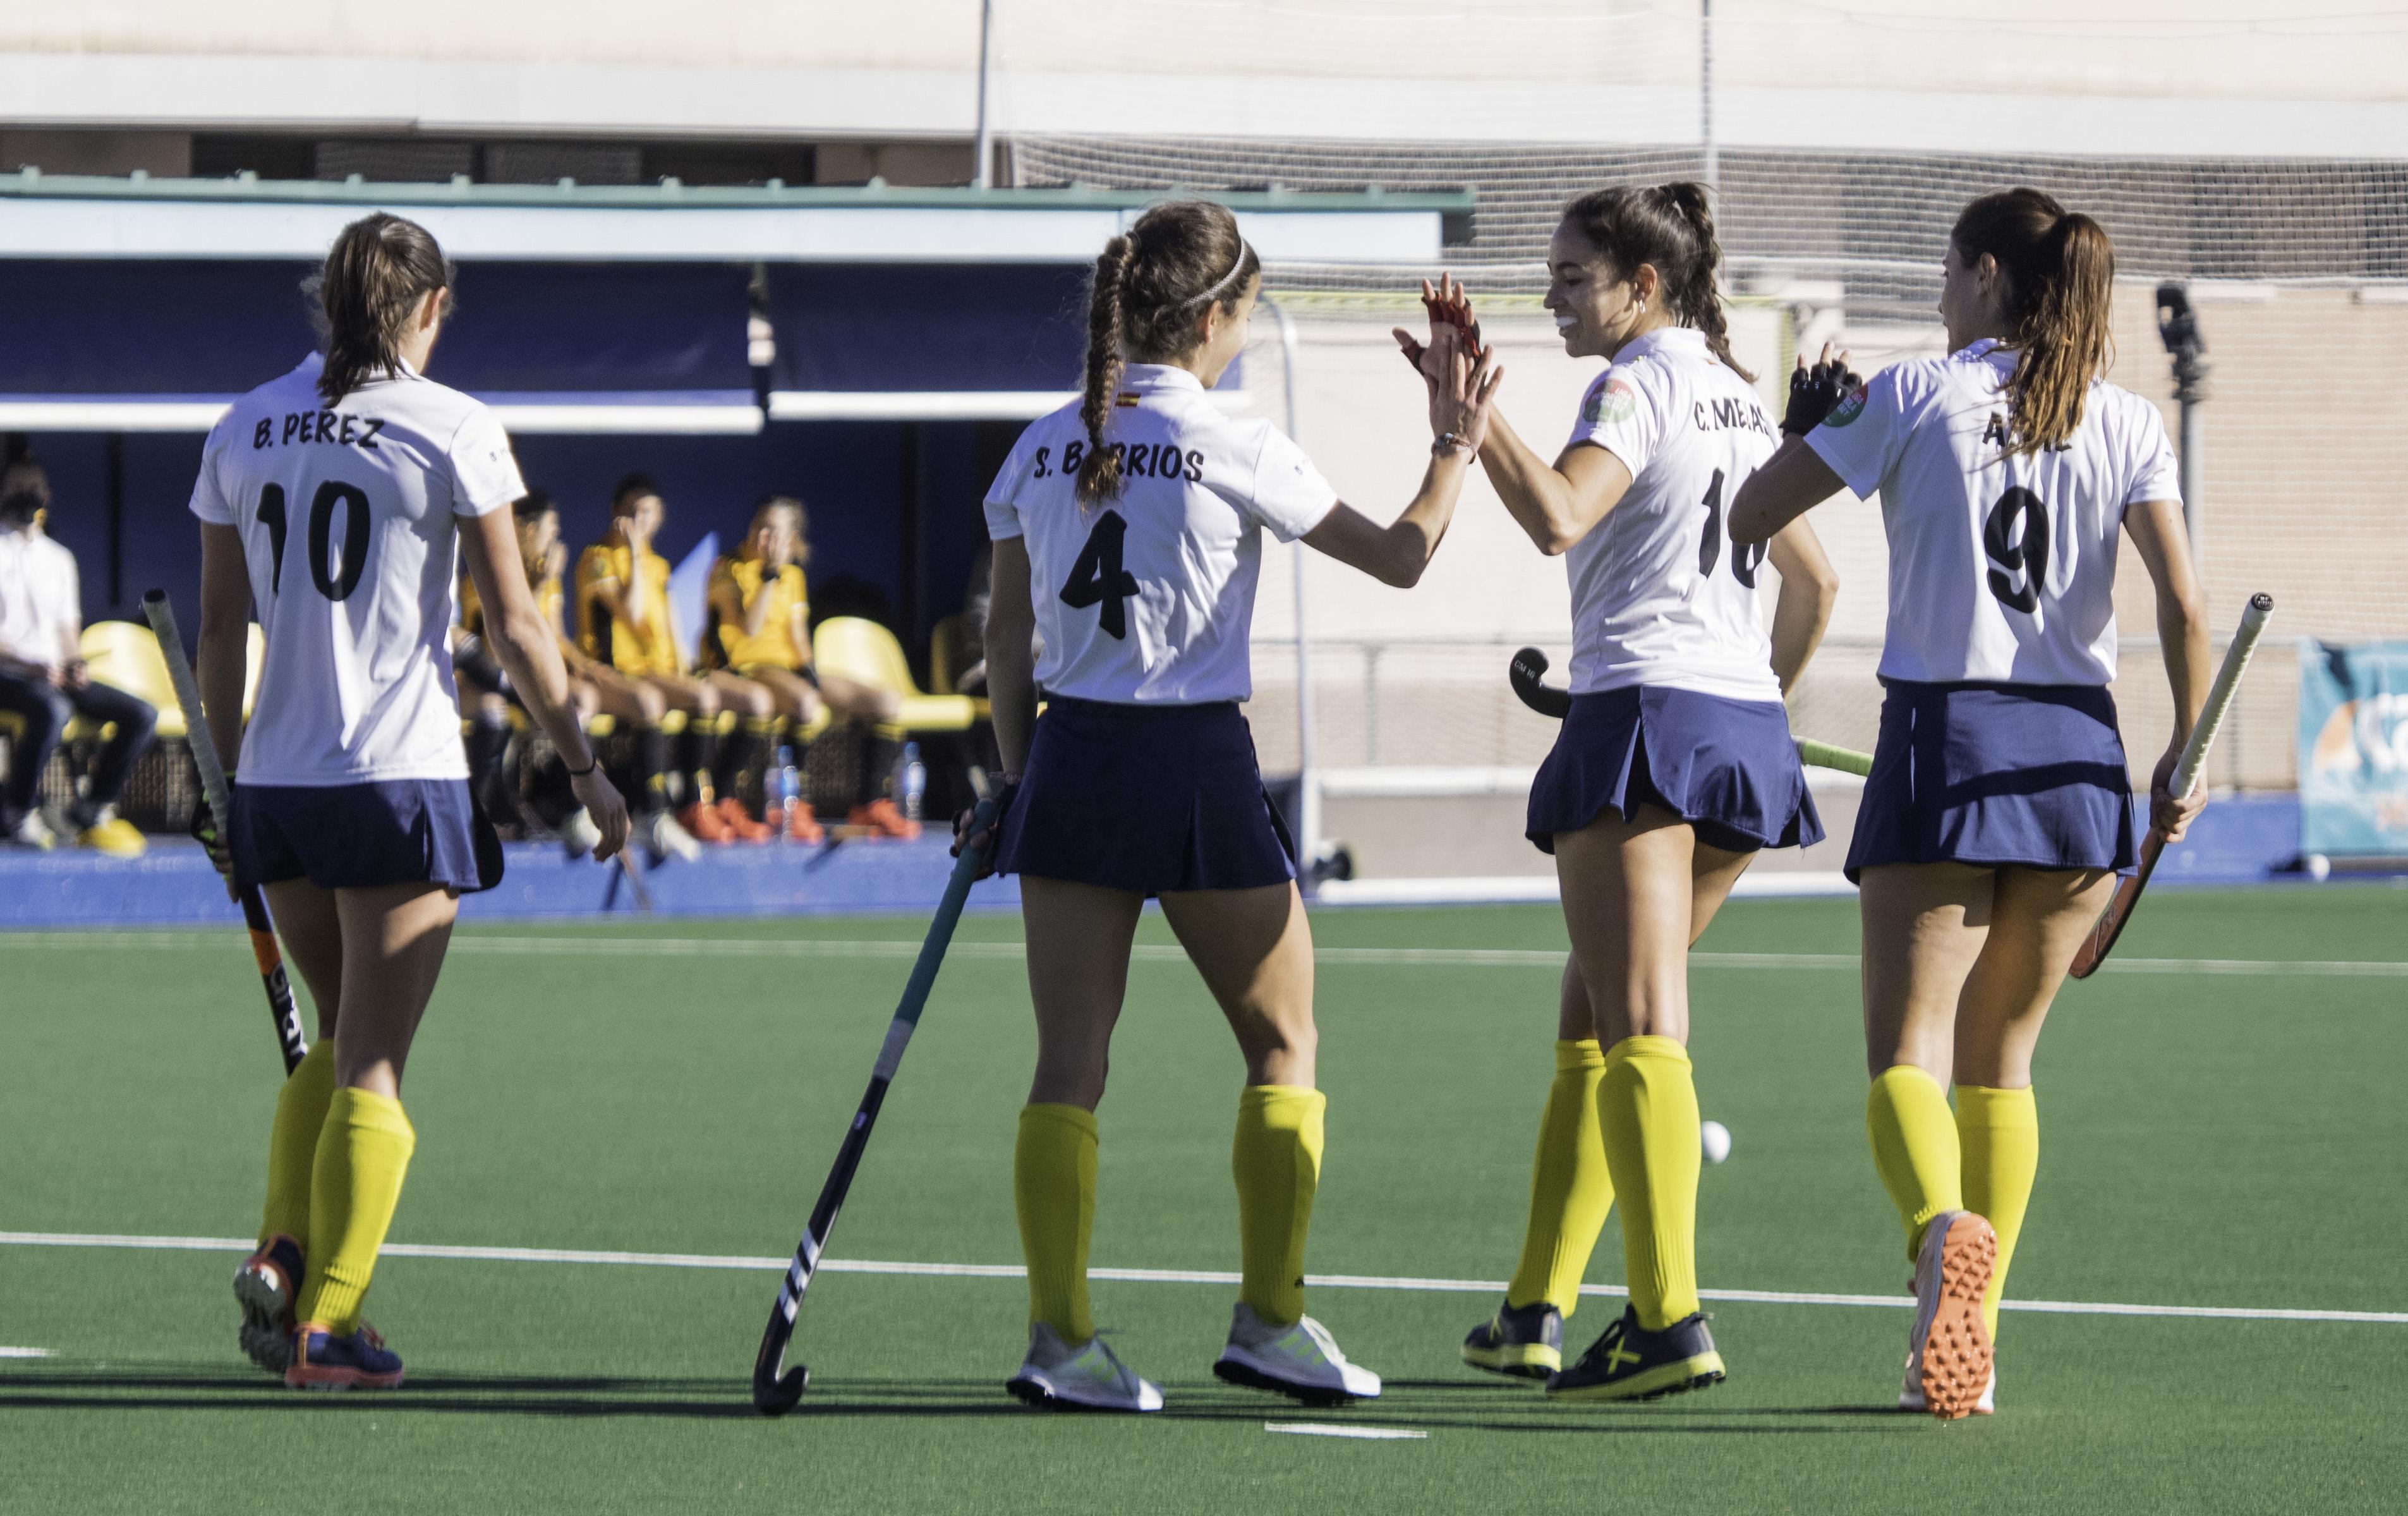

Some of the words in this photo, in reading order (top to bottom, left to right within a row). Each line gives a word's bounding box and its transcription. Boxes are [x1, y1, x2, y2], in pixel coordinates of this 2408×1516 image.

[254, 418, 274, 450] B.
[282, 411, 385, 449] PEREZ
[1694, 400, 1710, 431] C.
[1034, 446, 1053, 478] S.
[1062, 440, 1205, 482] BRRIOS
[257, 480, 371, 601] 10
[1060, 509, 1141, 640] 4
[1984, 485, 2050, 614] 9
